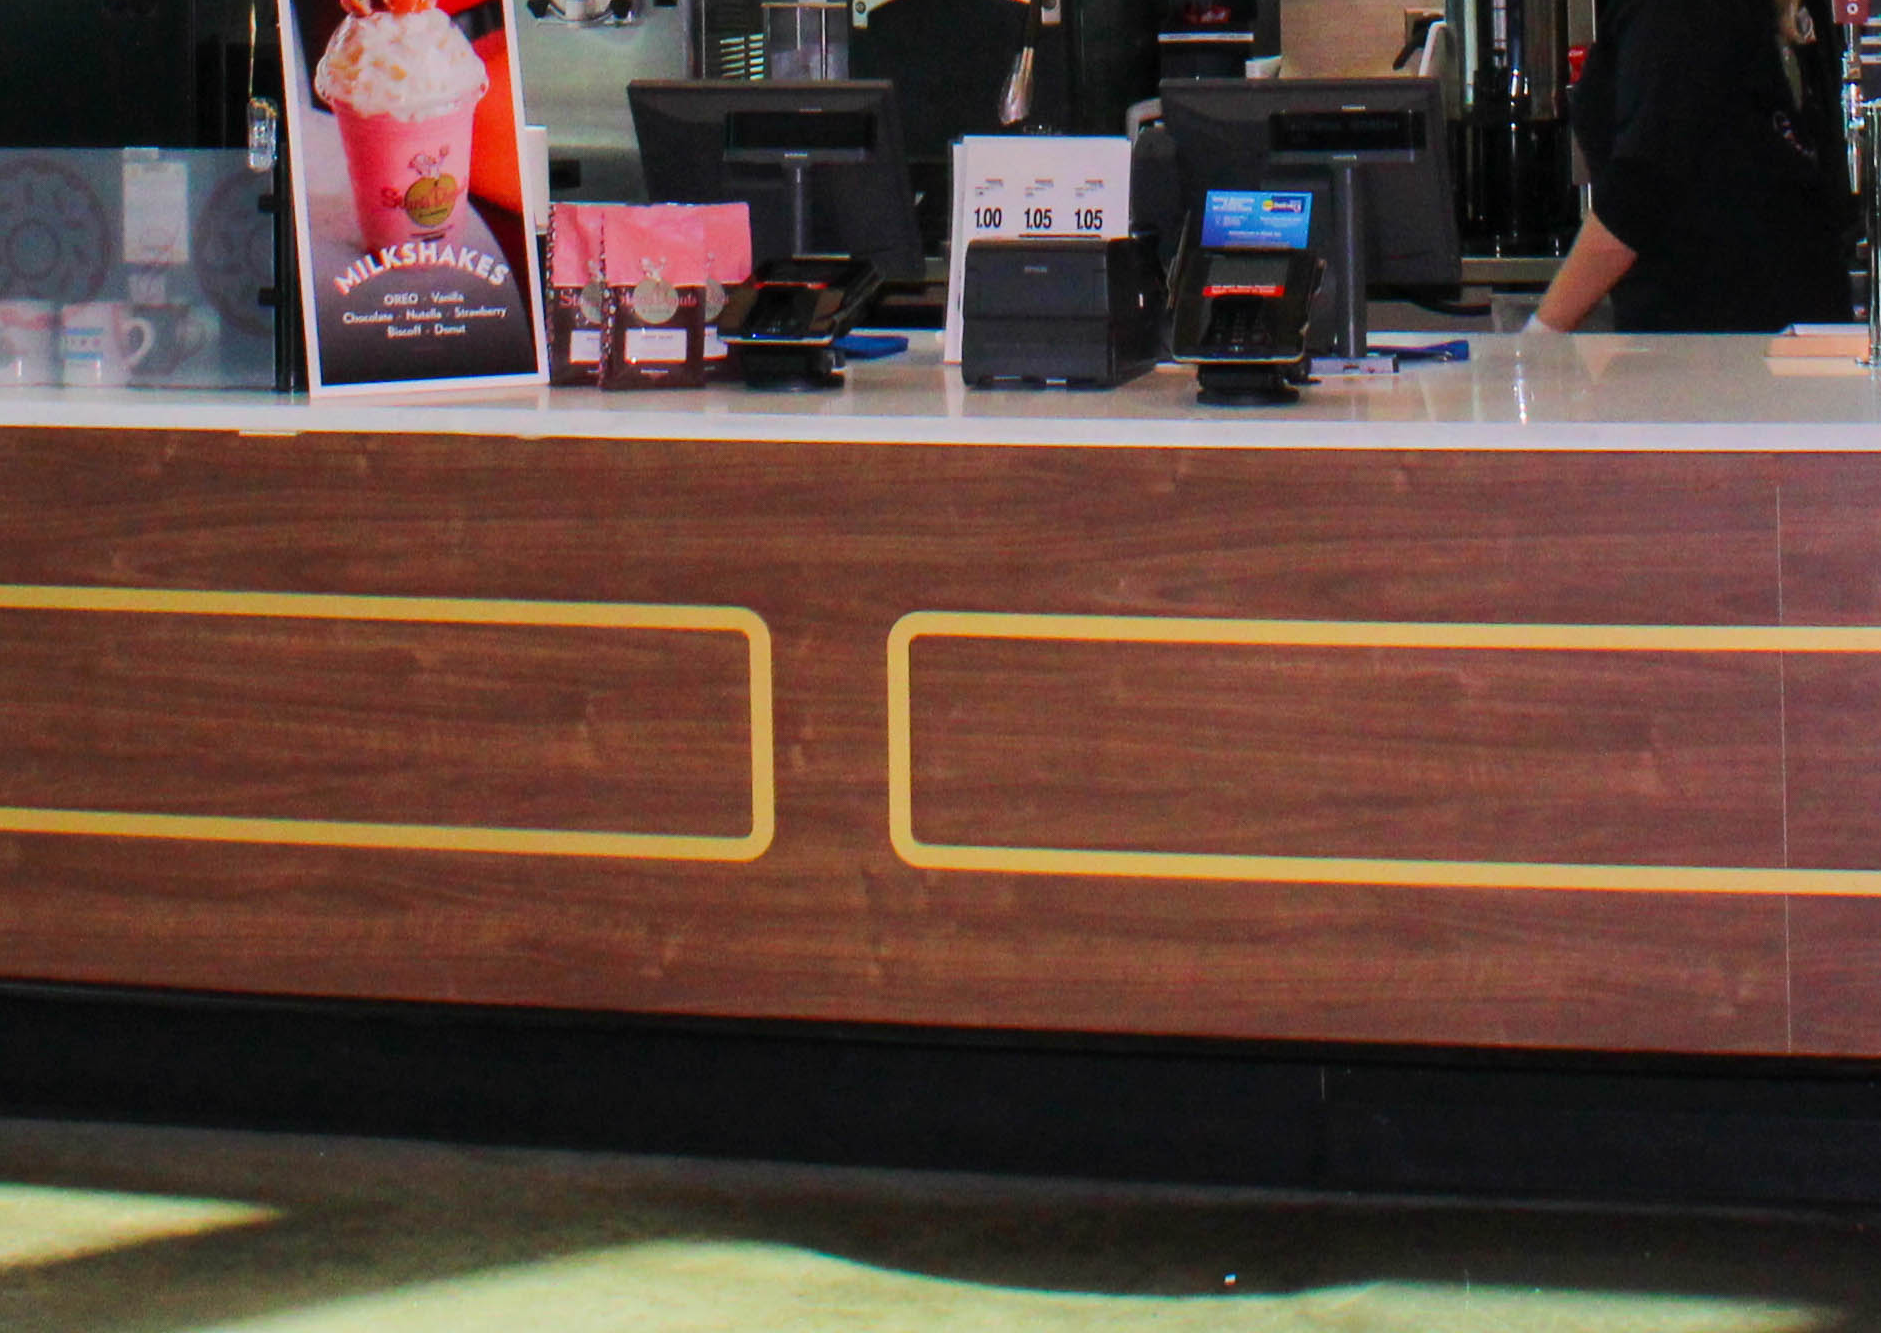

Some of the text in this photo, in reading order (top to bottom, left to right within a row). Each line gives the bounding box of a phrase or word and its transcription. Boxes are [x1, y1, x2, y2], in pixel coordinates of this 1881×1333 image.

[974, 208, 1003, 229] 1.00
[1024, 208, 1053, 229] 1.05
[1074, 209, 1104, 230] 1.05
[333, 241, 510, 296] MILKSHAKES
[383, 291, 464, 305] OREO Vanilla
[342, 305, 507, 324] Chocolate Nutella Strawberry
[387, 323, 466, 338] Biscoff Donut
